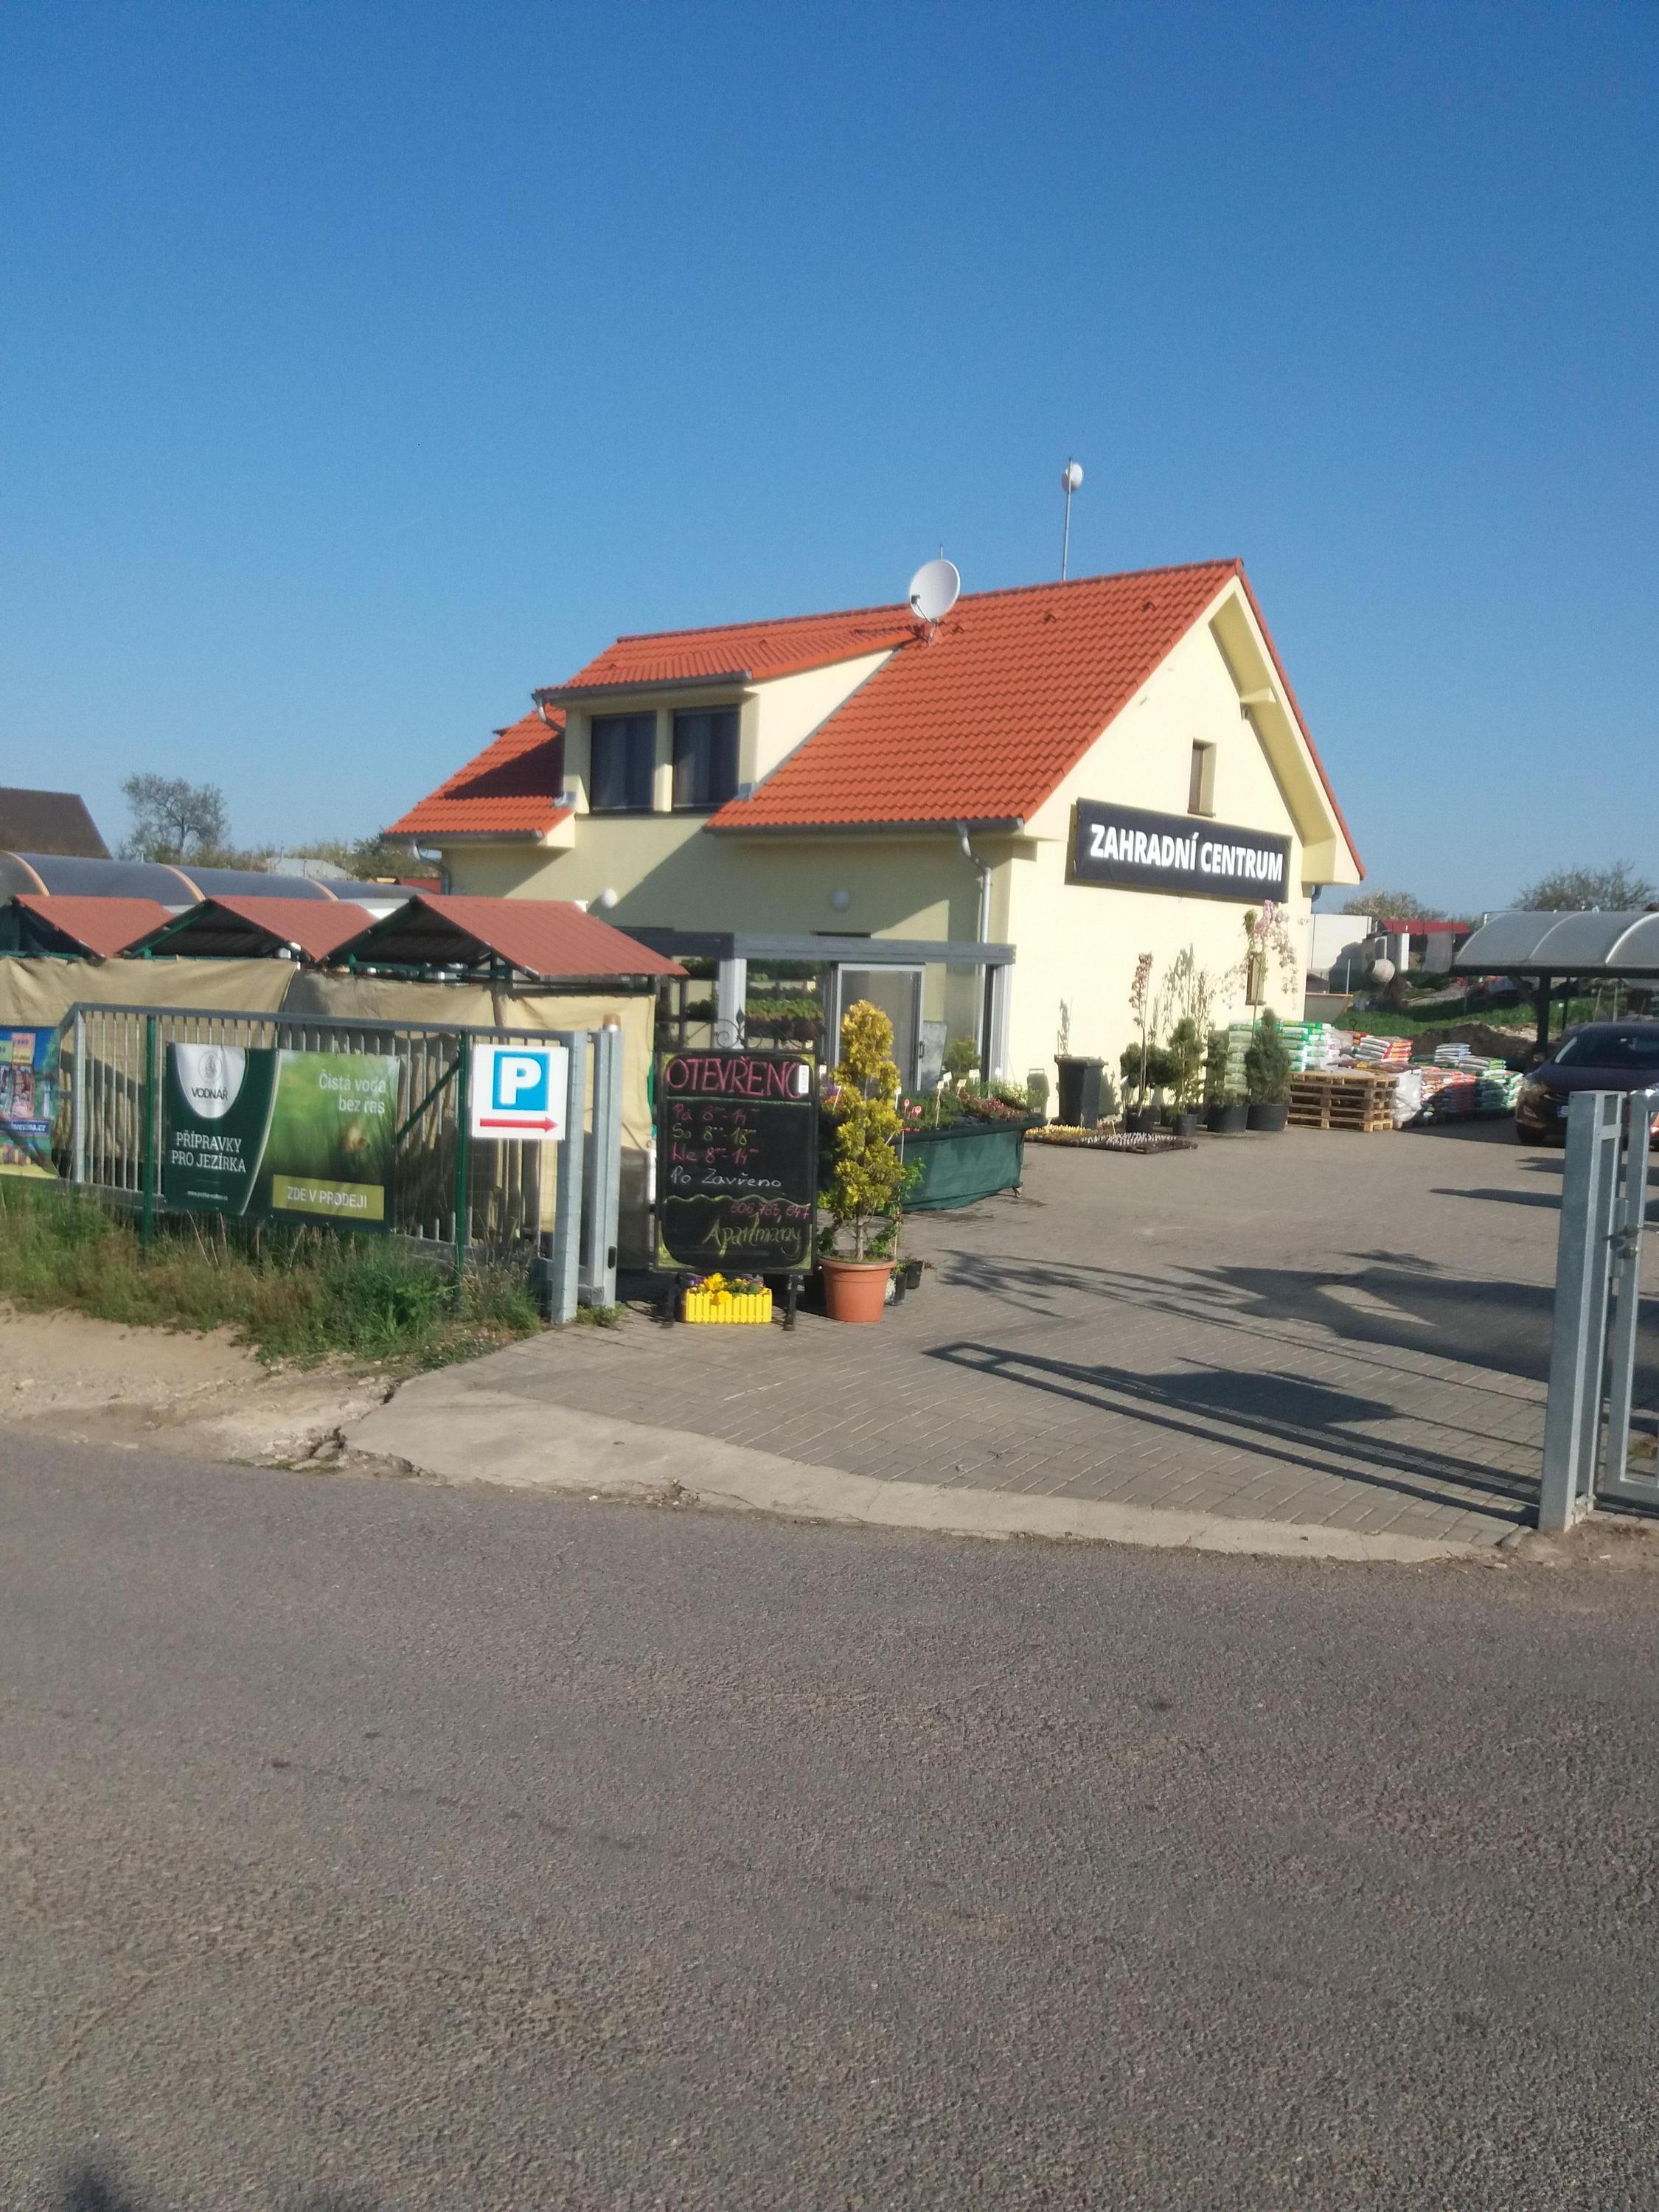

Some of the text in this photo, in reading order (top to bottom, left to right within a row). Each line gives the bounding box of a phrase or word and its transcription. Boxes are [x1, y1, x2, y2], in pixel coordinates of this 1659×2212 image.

[1090, 824, 1283, 882] ZAHRADNÍ CENTRUM
[319, 1068, 386, 1093] Čistá voda
[500, 1057, 542, 1105] P
[191, 1086, 229, 1100] VODNÁŘ
[338, 1093, 386, 1114] bez ras
[175, 1130, 243, 1153] PŘÍPRAVKY
[672, 1122, 692, 1139] So
[171, 1150, 246, 1173] PRO JEZÍRKA
[672, 1142, 698, 1162] Ne
[670, 1165, 782, 1187] Po Zavřeno
[287, 1186, 367, 1208] ZDE V PRODEJI
